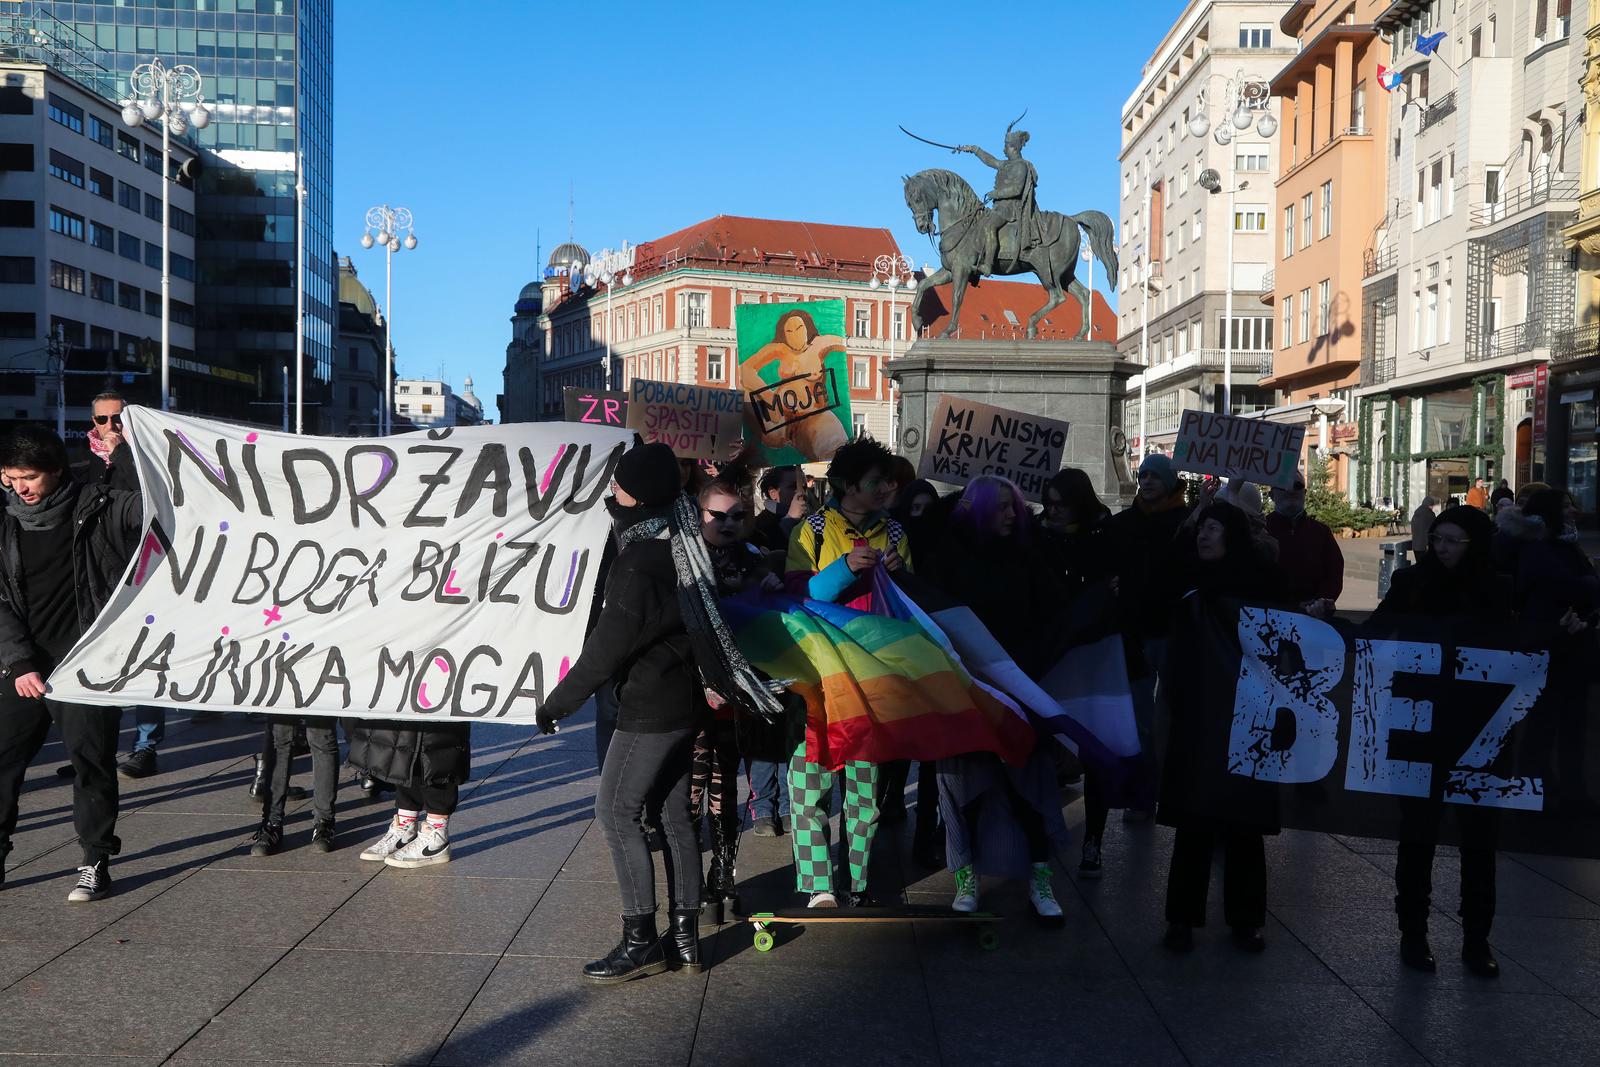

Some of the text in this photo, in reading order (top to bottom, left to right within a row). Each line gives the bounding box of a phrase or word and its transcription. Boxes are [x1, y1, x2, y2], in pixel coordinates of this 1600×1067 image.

[577, 395, 628, 423] ŽR
[634, 380, 743, 413] POBAČAJ MOŽE
[760, 381, 829, 423] MOJA
[645, 405, 720, 435] SPASITI
[945, 404, 1065, 449] MI NISMO
[1183, 412, 1273, 446] PUSTITE
[1271, 425, 1306, 453] ME
[932, 455, 970, 478] VAŠE
[936, 428, 1051, 472] KRIVE ZA
[1186, 440, 1219, 467] NA
[282, 428, 627, 528] DRŽAVU
[232, 532, 387, 613] BOGA
[1227, 605, 1550, 812] BEZ
